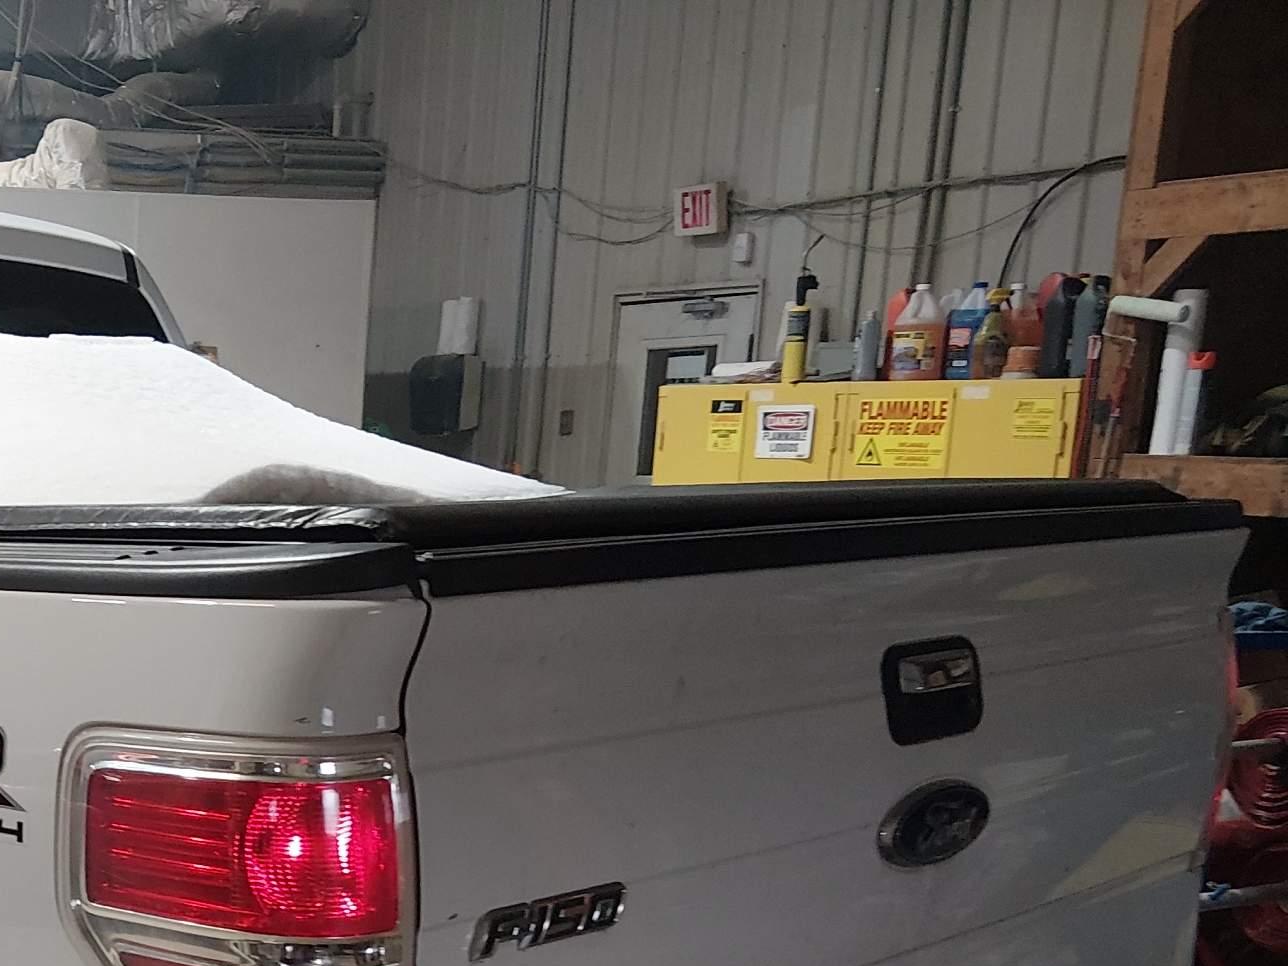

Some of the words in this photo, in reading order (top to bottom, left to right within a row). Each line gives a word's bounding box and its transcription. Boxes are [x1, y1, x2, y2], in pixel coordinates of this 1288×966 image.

[681, 190, 712, 229] EXIT
[859, 400, 949, 420] FLAMMABLE
[857, 422, 885, 435] KEEP
[886, 422, 913, 435] FIRE
[912, 422, 945, 435] AWAY
